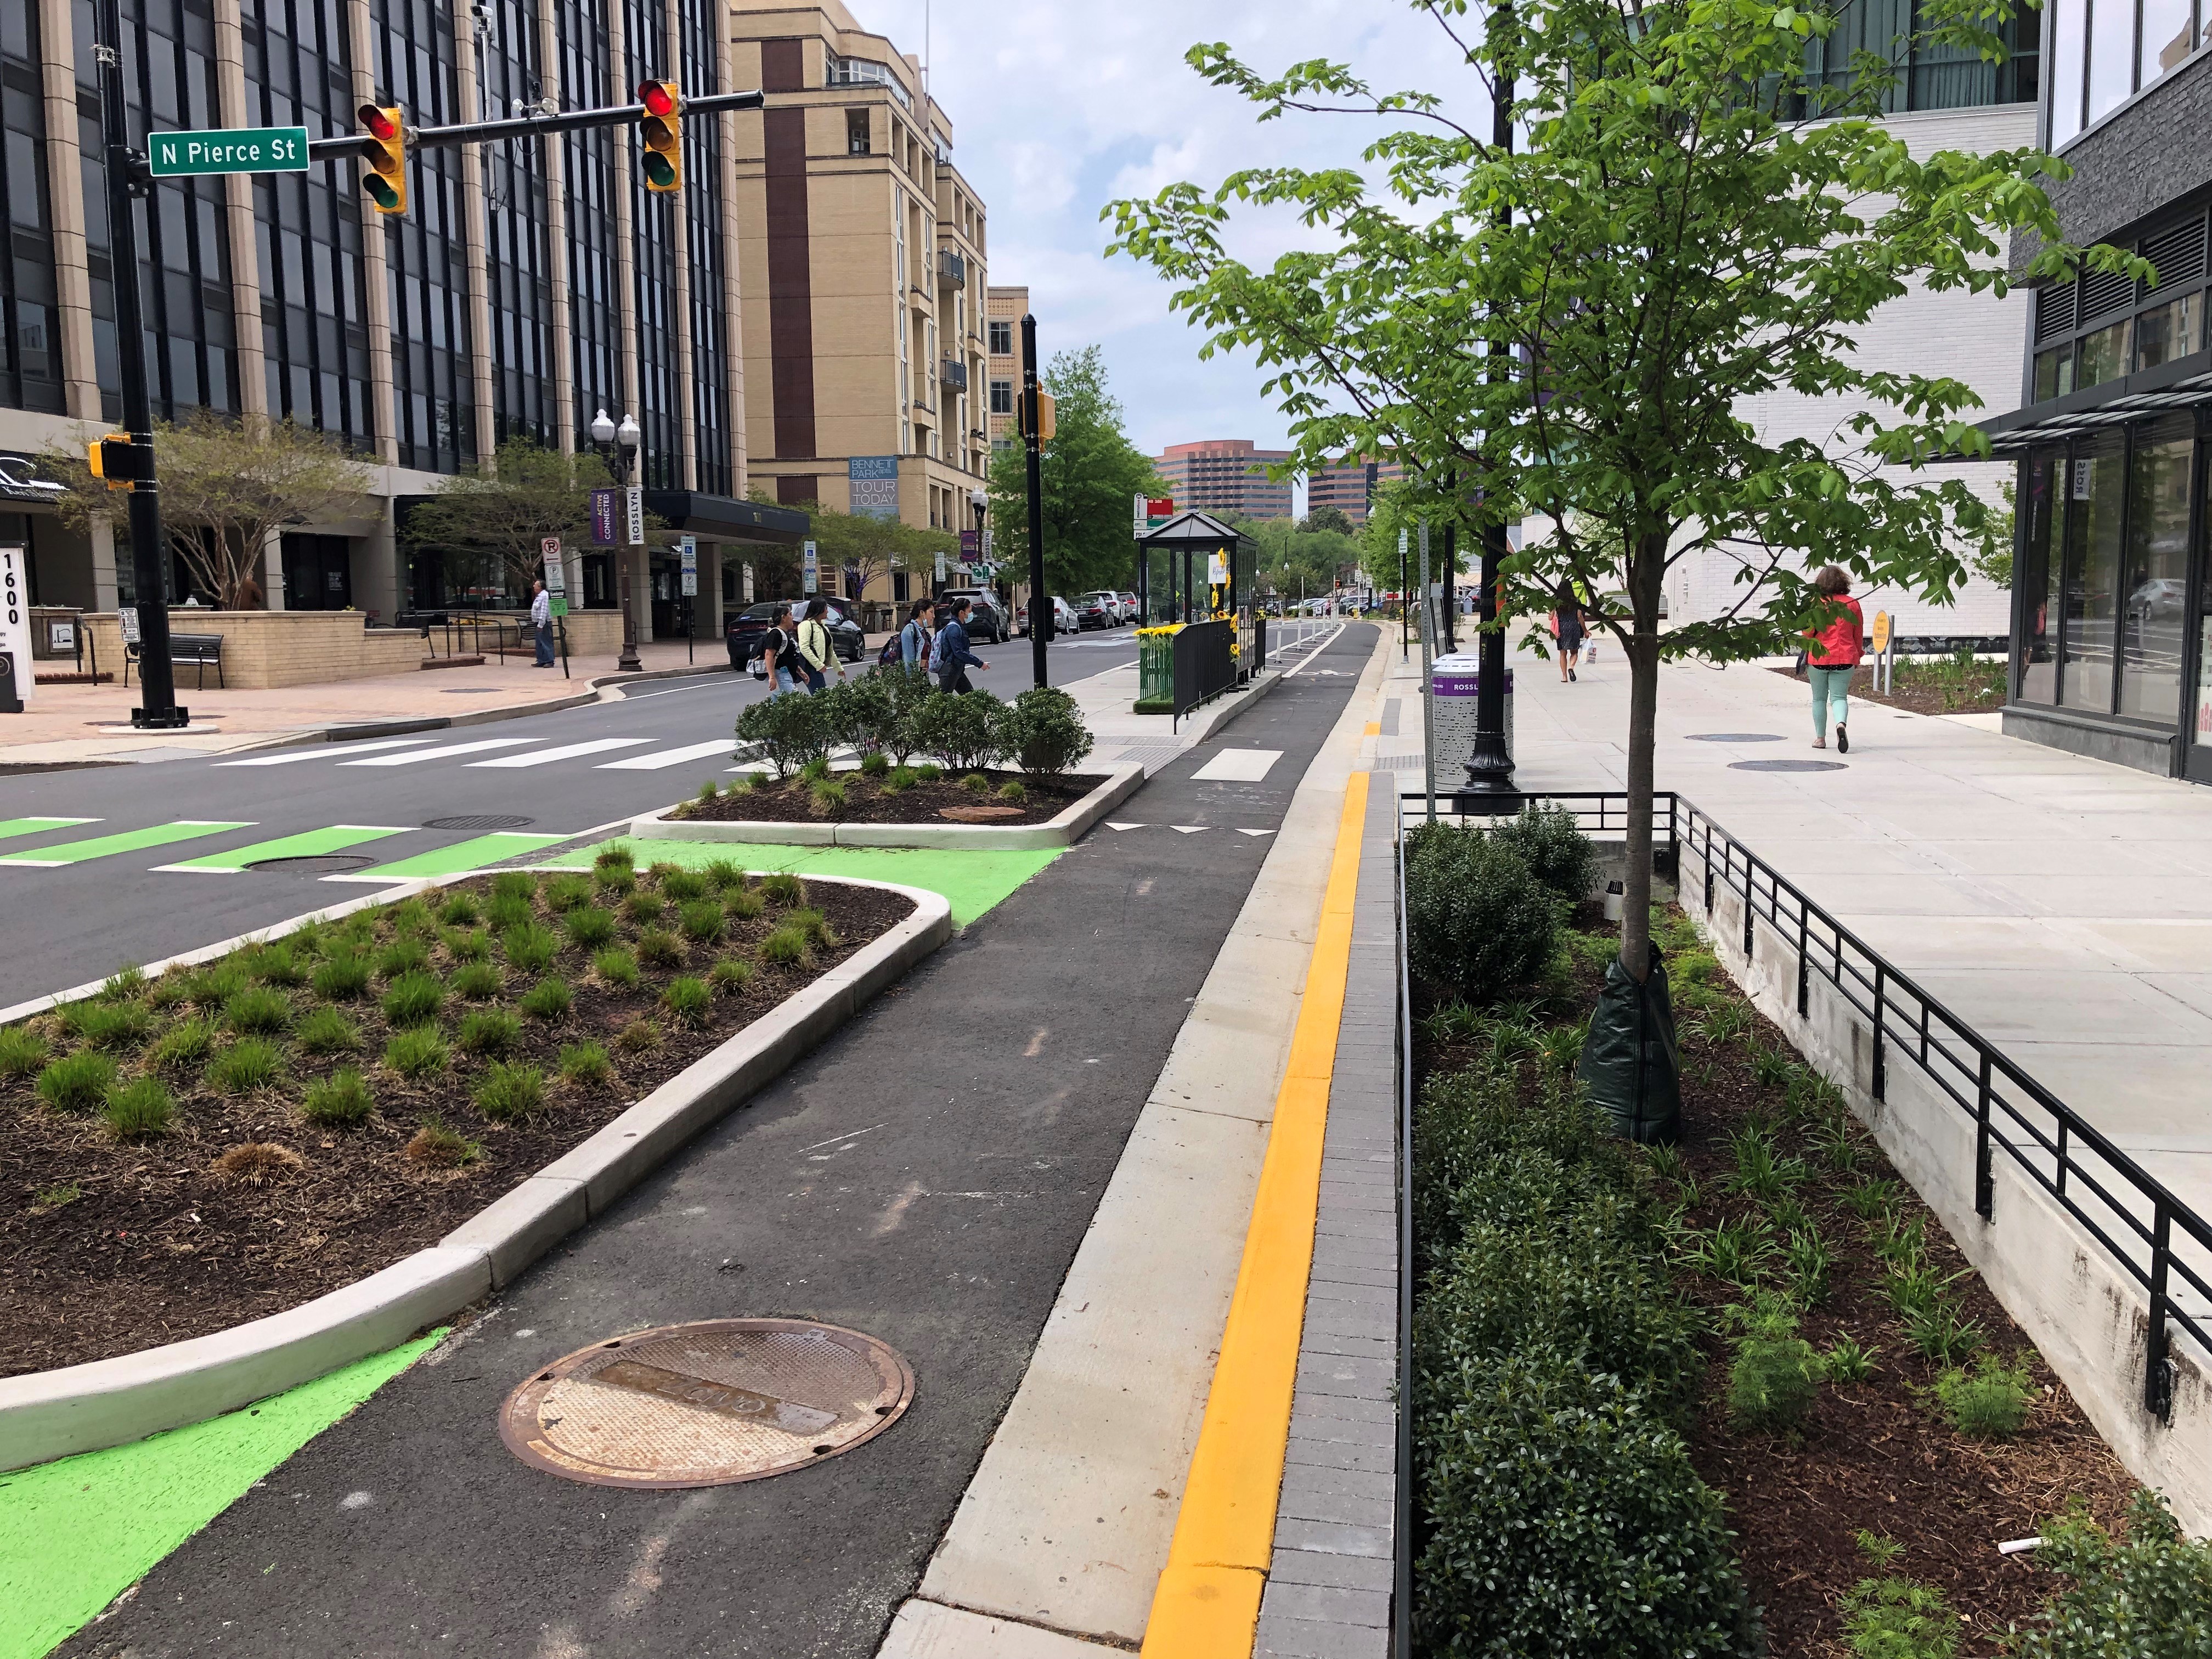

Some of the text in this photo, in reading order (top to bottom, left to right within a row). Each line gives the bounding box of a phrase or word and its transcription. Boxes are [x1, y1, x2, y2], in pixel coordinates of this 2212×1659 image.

[162, 138, 296, 165] N Pierce St
[852, 460, 894, 469] BENNETT
[852, 470, 879, 478] PARK
[852, 482, 895, 493] TOUR
[853, 494, 895, 505] TODAY
[603, 494, 611, 540] CONNECTED
[630, 492, 640, 540] ROSSLYN
[4, 554, 18, 624] 1600
